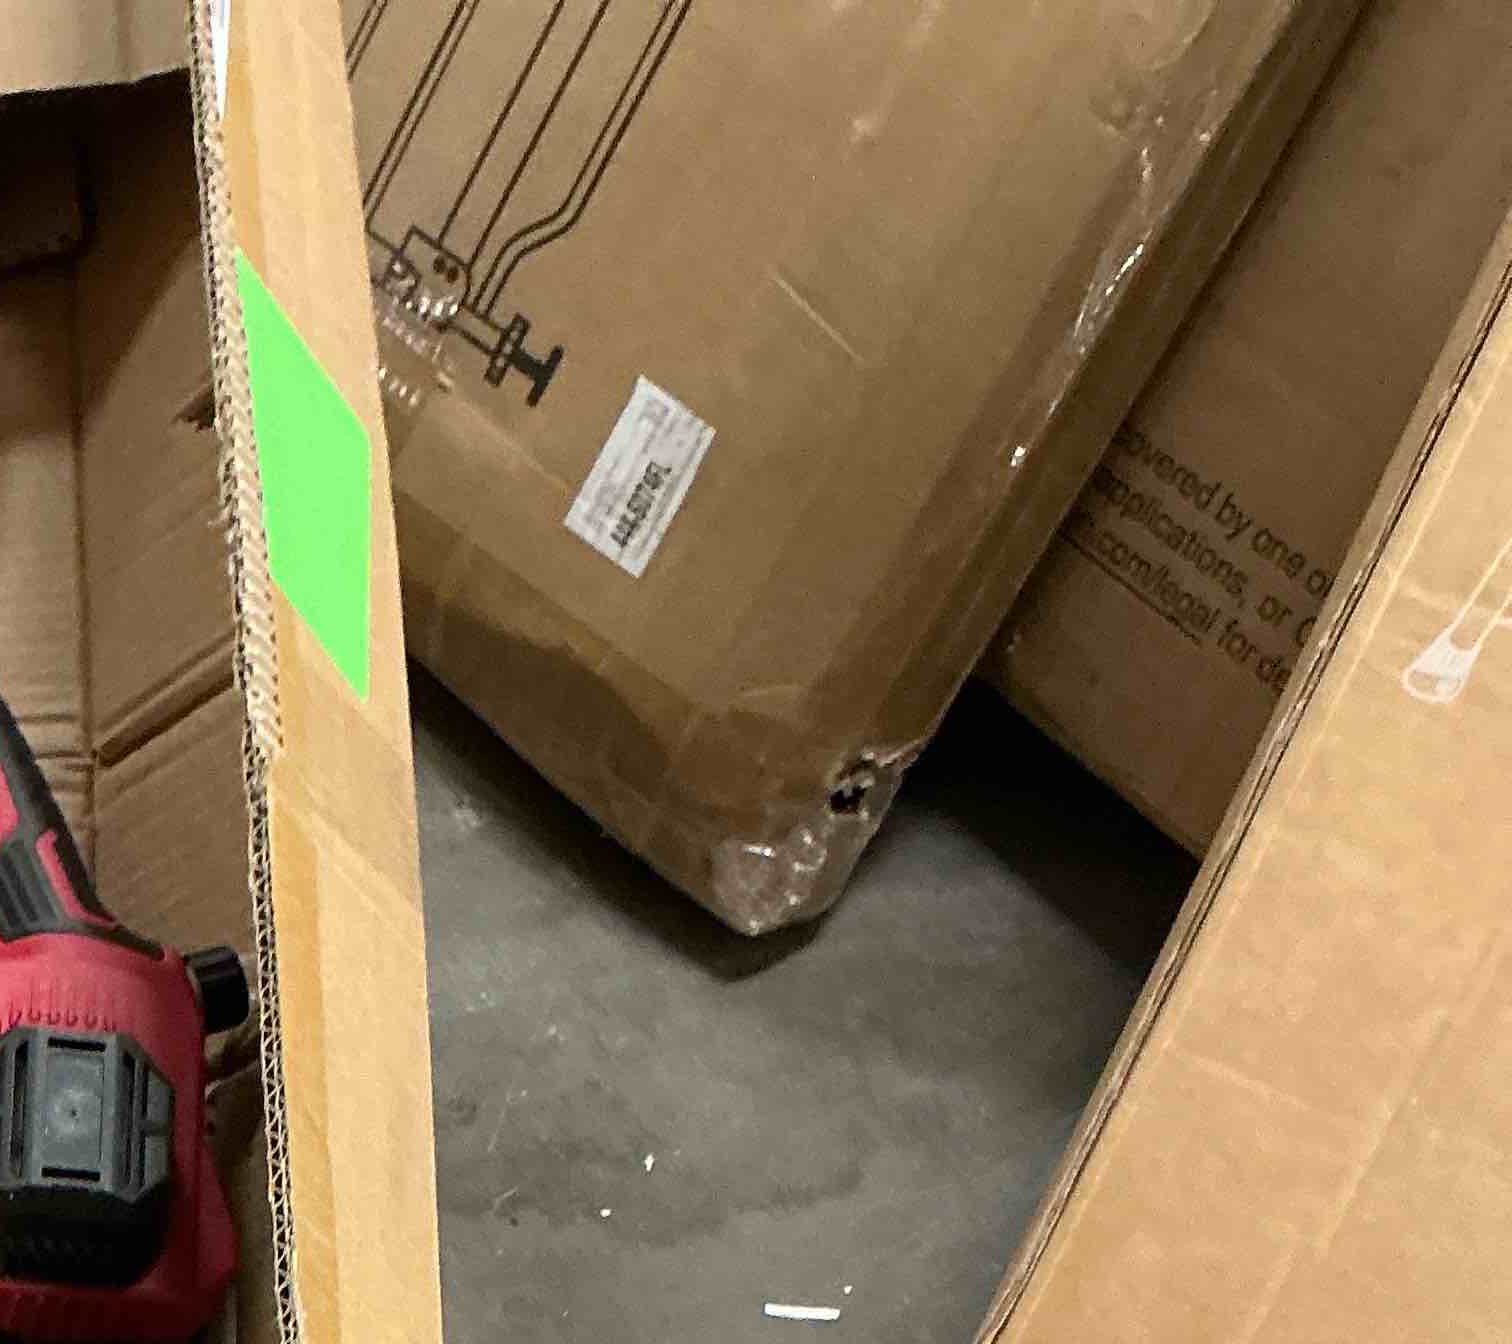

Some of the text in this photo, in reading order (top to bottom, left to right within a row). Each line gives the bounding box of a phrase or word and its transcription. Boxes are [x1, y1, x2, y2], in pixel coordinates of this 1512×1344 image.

[1214, 491, 1252, 541] by
[1250, 527, 1307, 579] one
[1256, 595, 1294, 638] or
